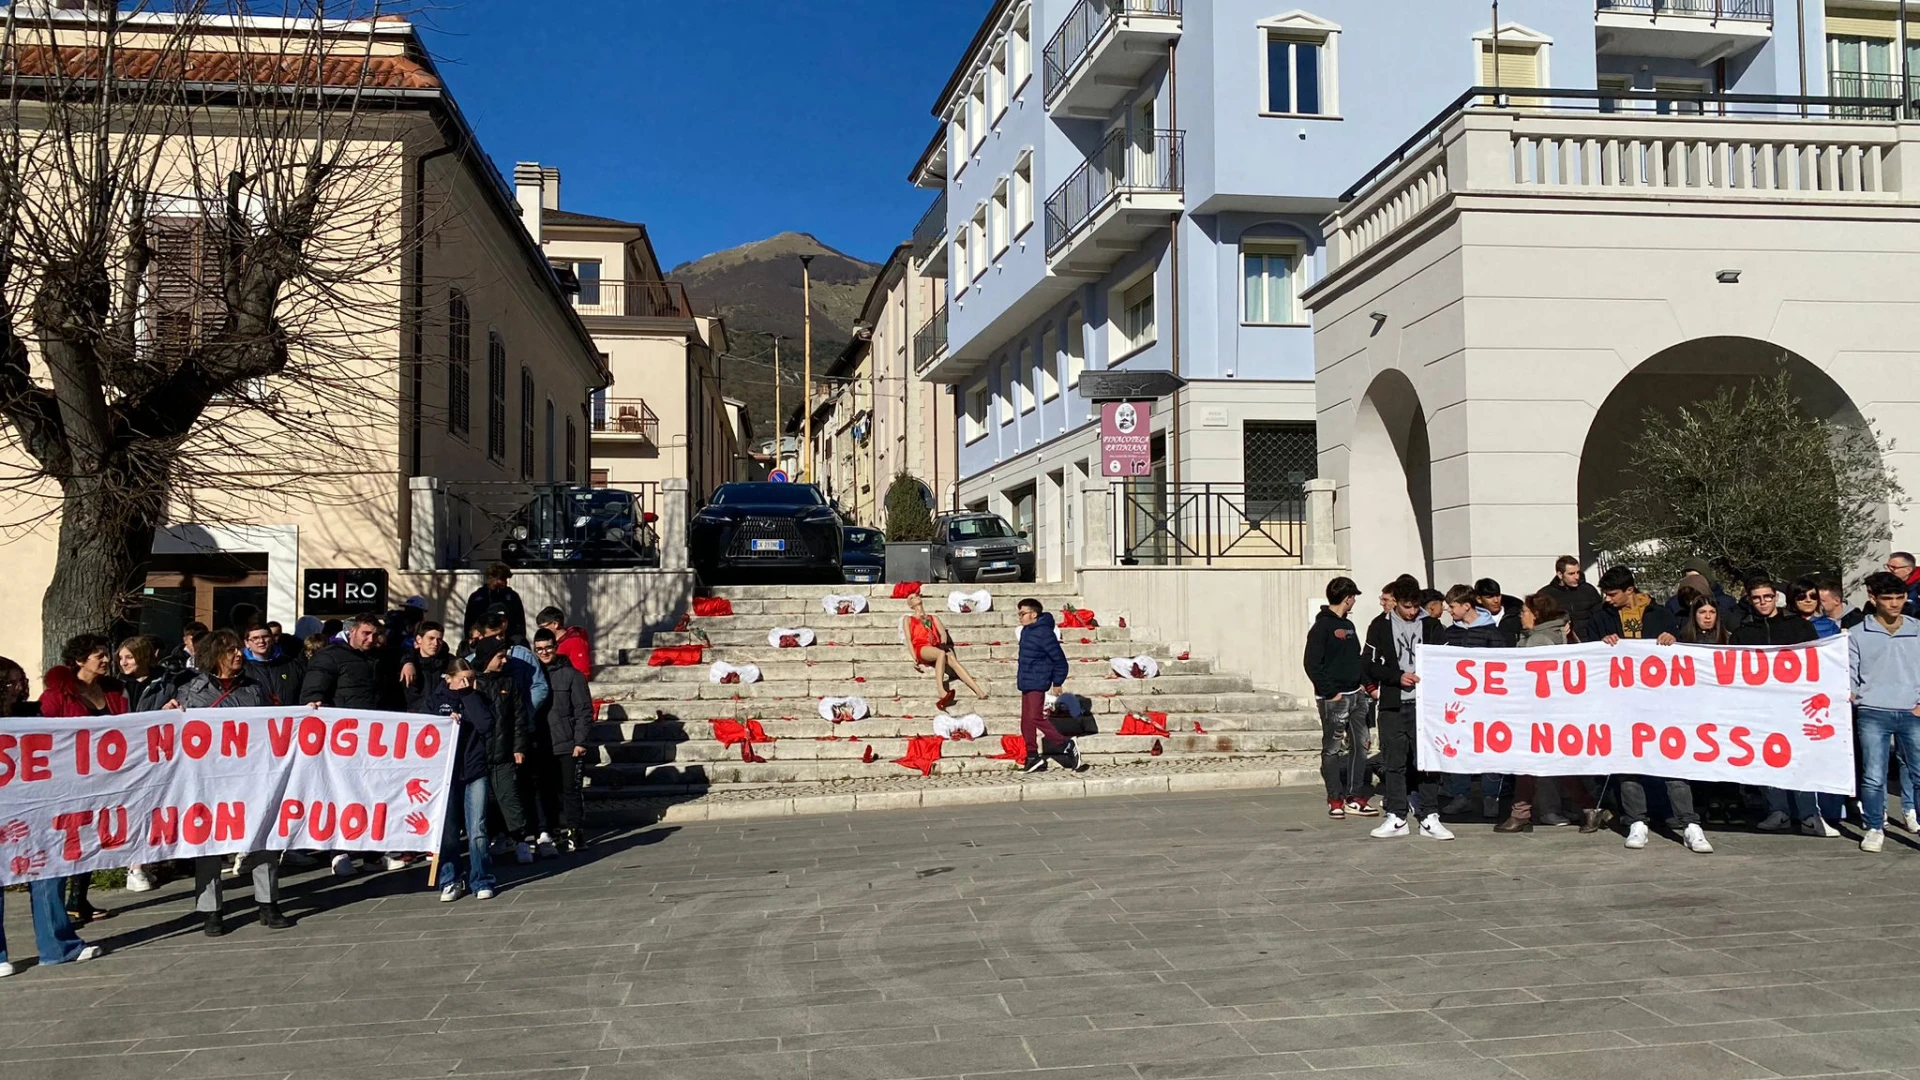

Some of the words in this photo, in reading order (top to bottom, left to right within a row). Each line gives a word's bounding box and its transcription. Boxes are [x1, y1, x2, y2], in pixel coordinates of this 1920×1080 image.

[1103, 435, 1150, 443] PINACOTECA
[1455, 660, 1508, 695] SE
[1525, 660, 1587, 698] TU
[1610, 655, 1695, 688] NON
[1714, 647, 1820, 687] VUOI
[76, 729, 128, 775] IO
[147, 720, 249, 763] NON
[267, 715, 441, 760] VOGLIO
[1473, 721, 1513, 753] IO
[1531, 722, 1612, 757] NON
[1632, 722, 1792, 768] POSSO
[52, 805, 127, 861] TU
[149, 801, 246, 846] NON
[278, 799, 388, 842] PUOI
